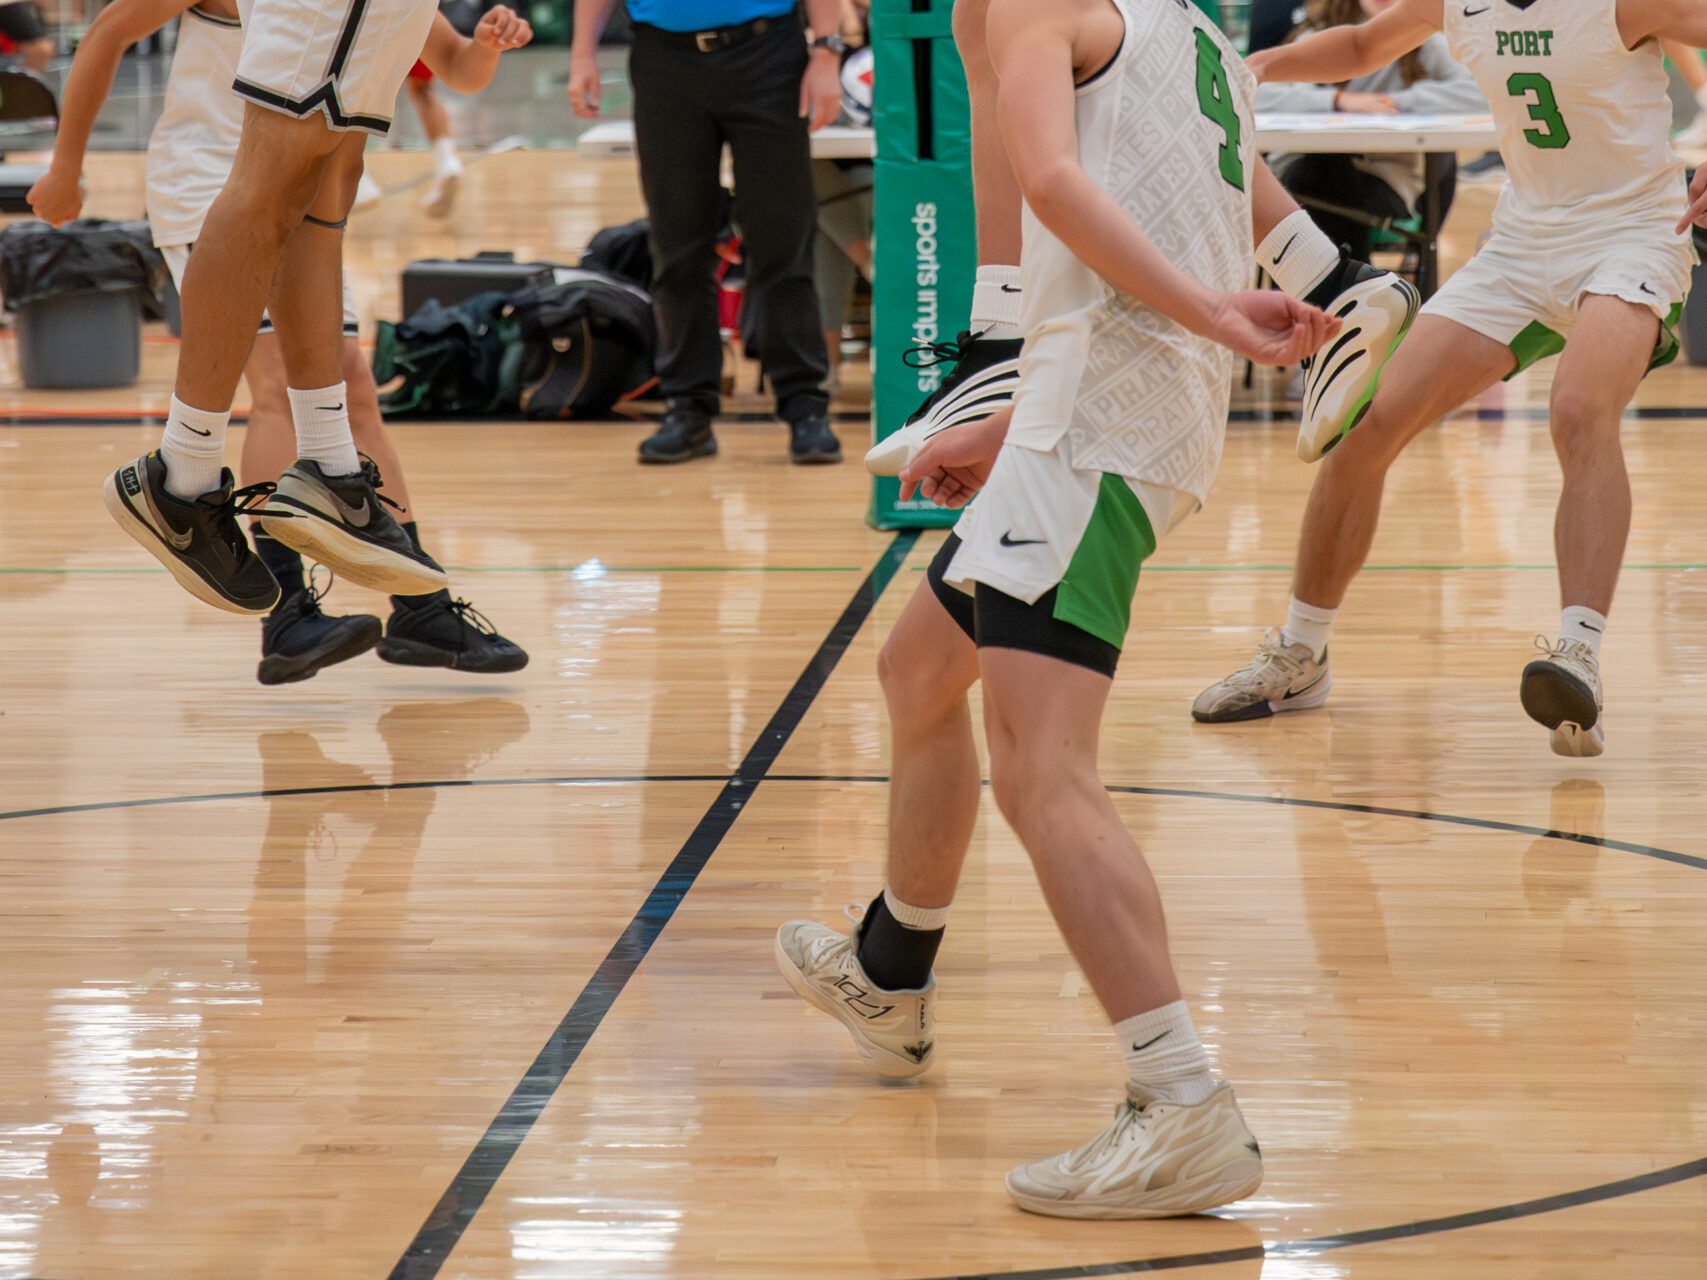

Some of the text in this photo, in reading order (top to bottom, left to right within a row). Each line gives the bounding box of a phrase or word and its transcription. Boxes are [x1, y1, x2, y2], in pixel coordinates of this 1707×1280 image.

[1495, 30, 1554, 56] PORT
[1193, 26, 1245, 194] 4
[1506, 72, 1571, 149] 3
[911, 202, 941, 287] sports
